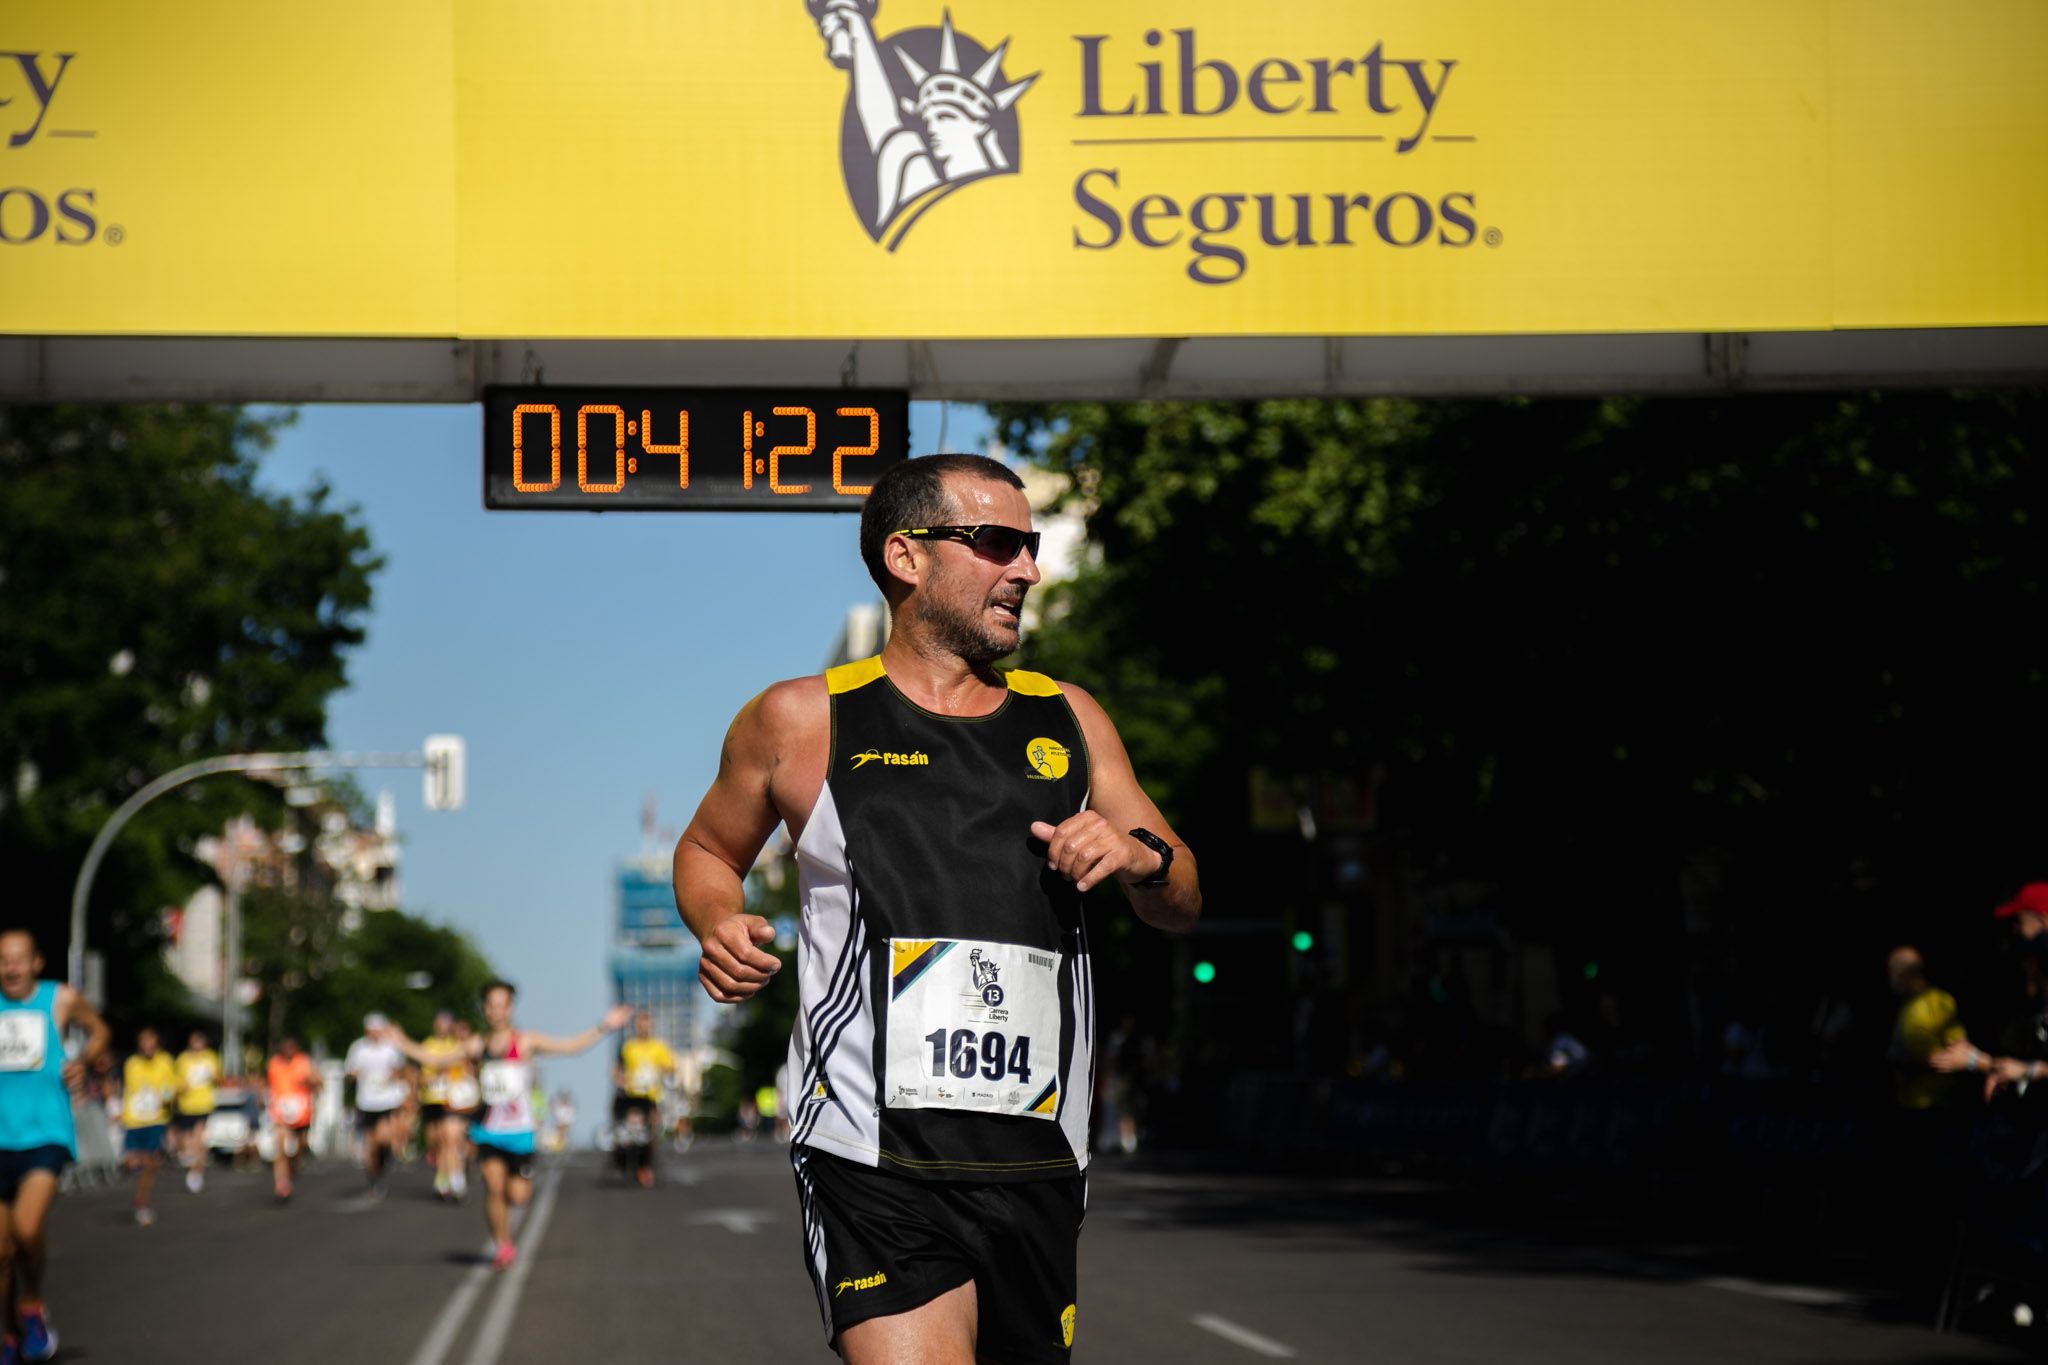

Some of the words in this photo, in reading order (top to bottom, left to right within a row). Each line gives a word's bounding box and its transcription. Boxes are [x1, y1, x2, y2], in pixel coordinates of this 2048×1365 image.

[0, 51, 77, 148] y
[1072, 28, 1458, 153] Liberty
[1072, 167, 1477, 285] Seguros
[883, 750, 929, 766] rasán
[987, 989, 1000, 1002] 13
[988, 1013, 1009, 1023] Liberty
[925, 1028, 1031, 1084] 1694
[854, 1270, 887, 1291] rasán
